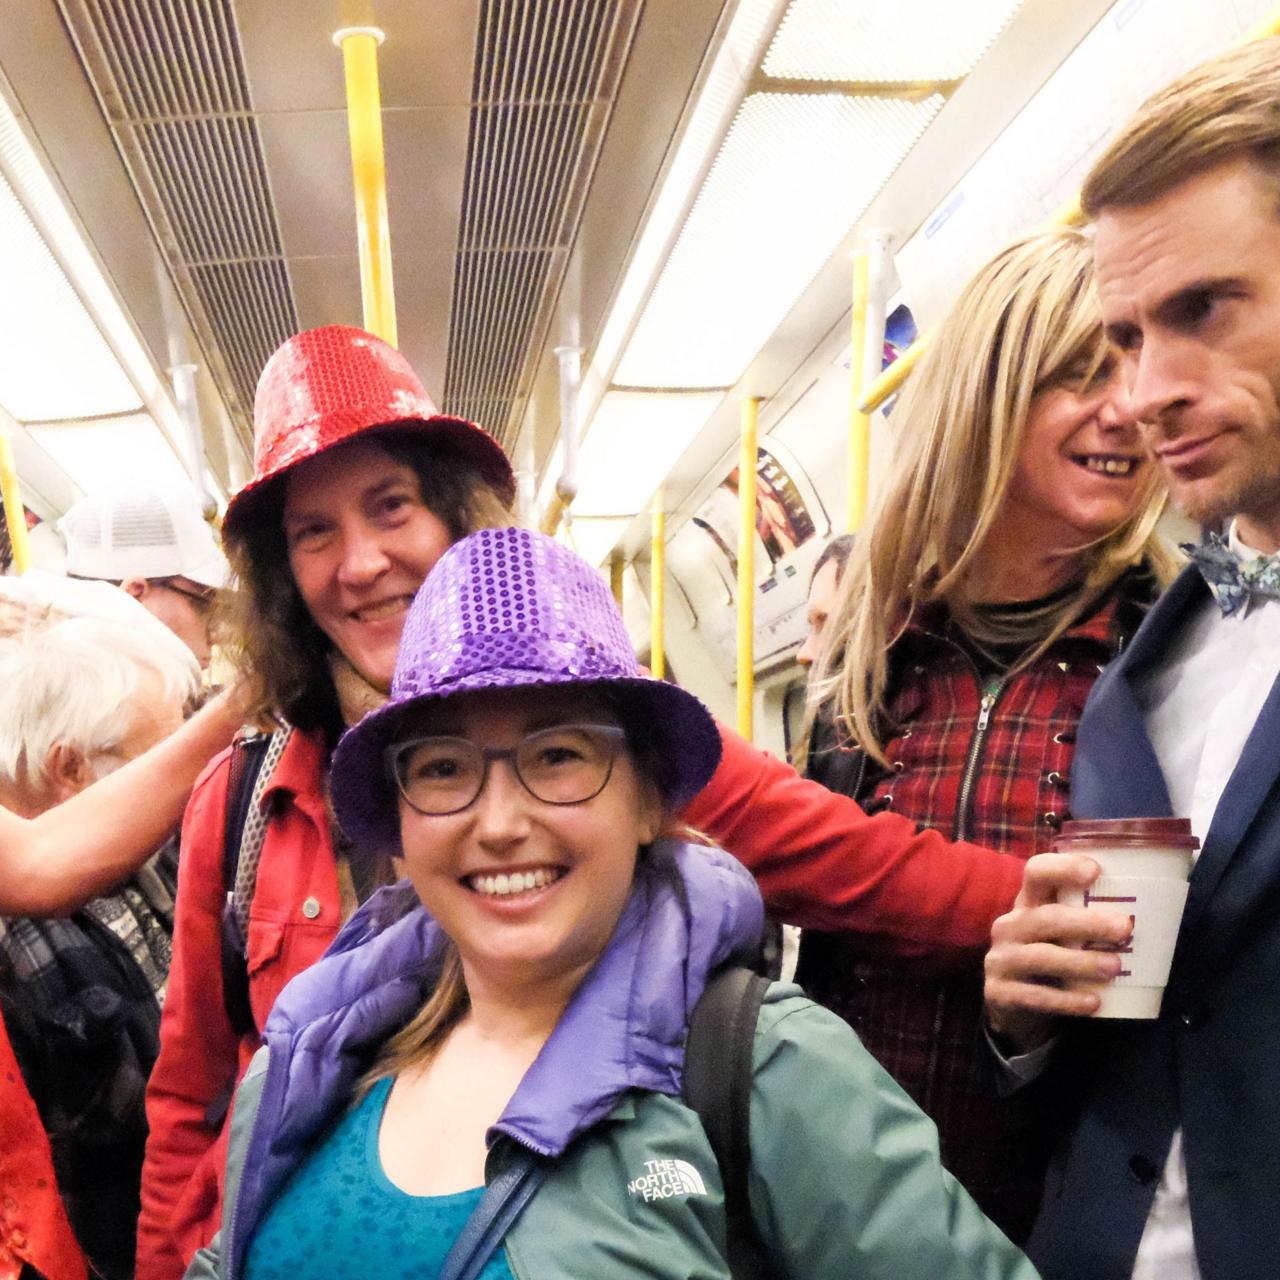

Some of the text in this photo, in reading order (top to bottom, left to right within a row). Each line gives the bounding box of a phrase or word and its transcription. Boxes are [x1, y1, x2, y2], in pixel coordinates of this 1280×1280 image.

[643, 1159, 675, 1174] THE
[627, 1169, 680, 1196] NORTH
[642, 1182, 684, 1203] FACE
